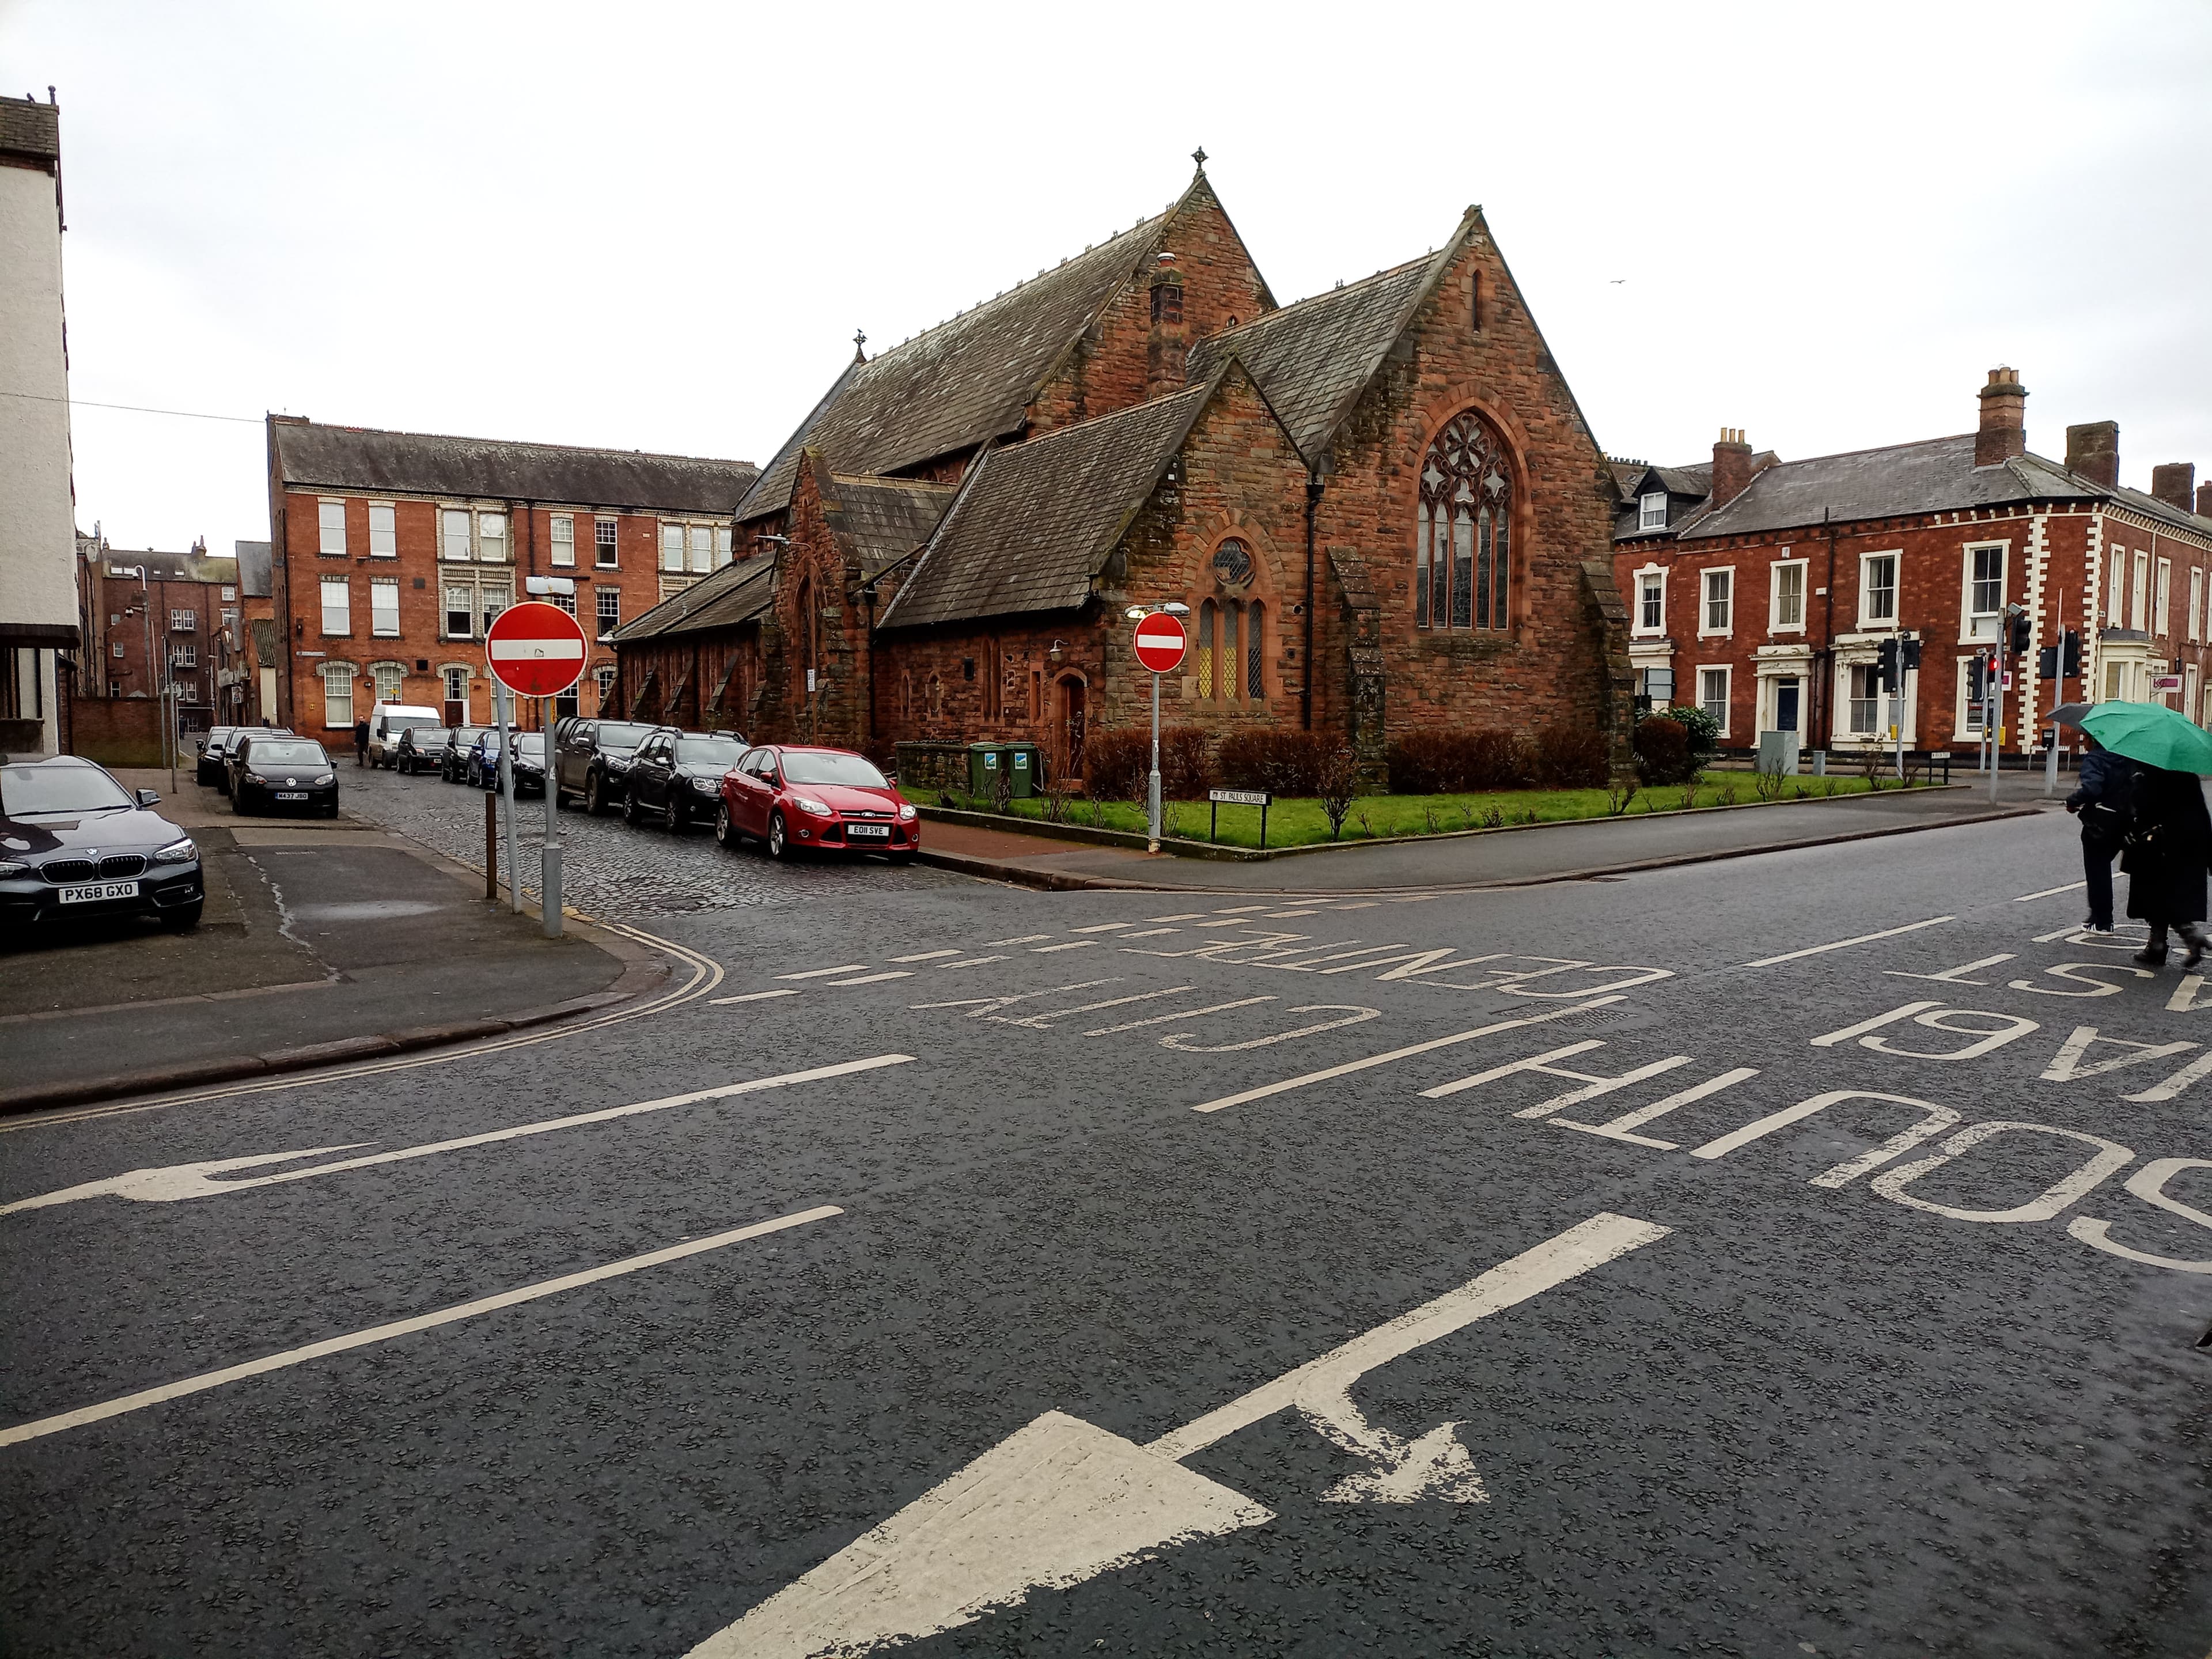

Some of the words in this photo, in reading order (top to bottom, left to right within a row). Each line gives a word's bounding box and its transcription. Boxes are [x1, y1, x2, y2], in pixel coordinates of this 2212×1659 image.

[1228, 793, 1243, 801] PAULS
[1244, 794, 1263, 803] SQUARE
[854, 826, 868, 834] EO11
[65, 887, 103, 902] PX68
[106, 884, 133, 897] GXO
[908, 976, 1382, 1054] CITY
